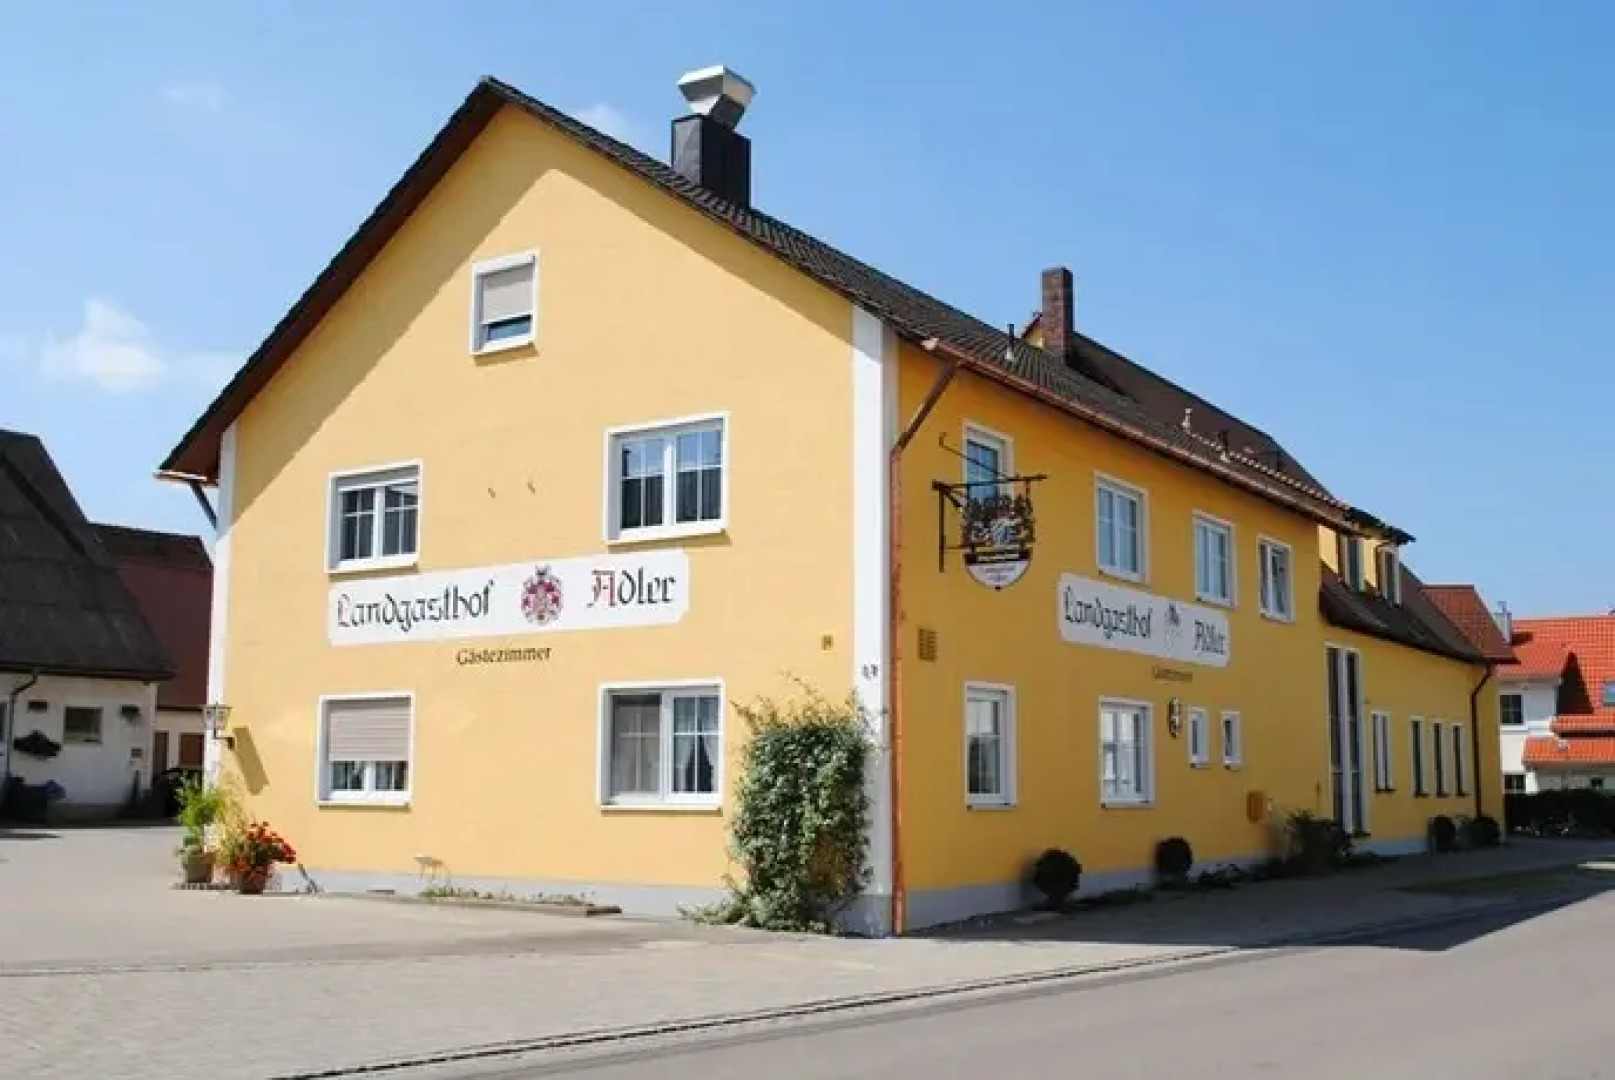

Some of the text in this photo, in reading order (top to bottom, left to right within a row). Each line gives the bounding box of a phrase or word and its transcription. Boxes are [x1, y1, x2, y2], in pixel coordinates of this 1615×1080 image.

[337, 567, 676, 632] Landgasthof Adler
[456, 646, 552, 665] Gästezimmer
